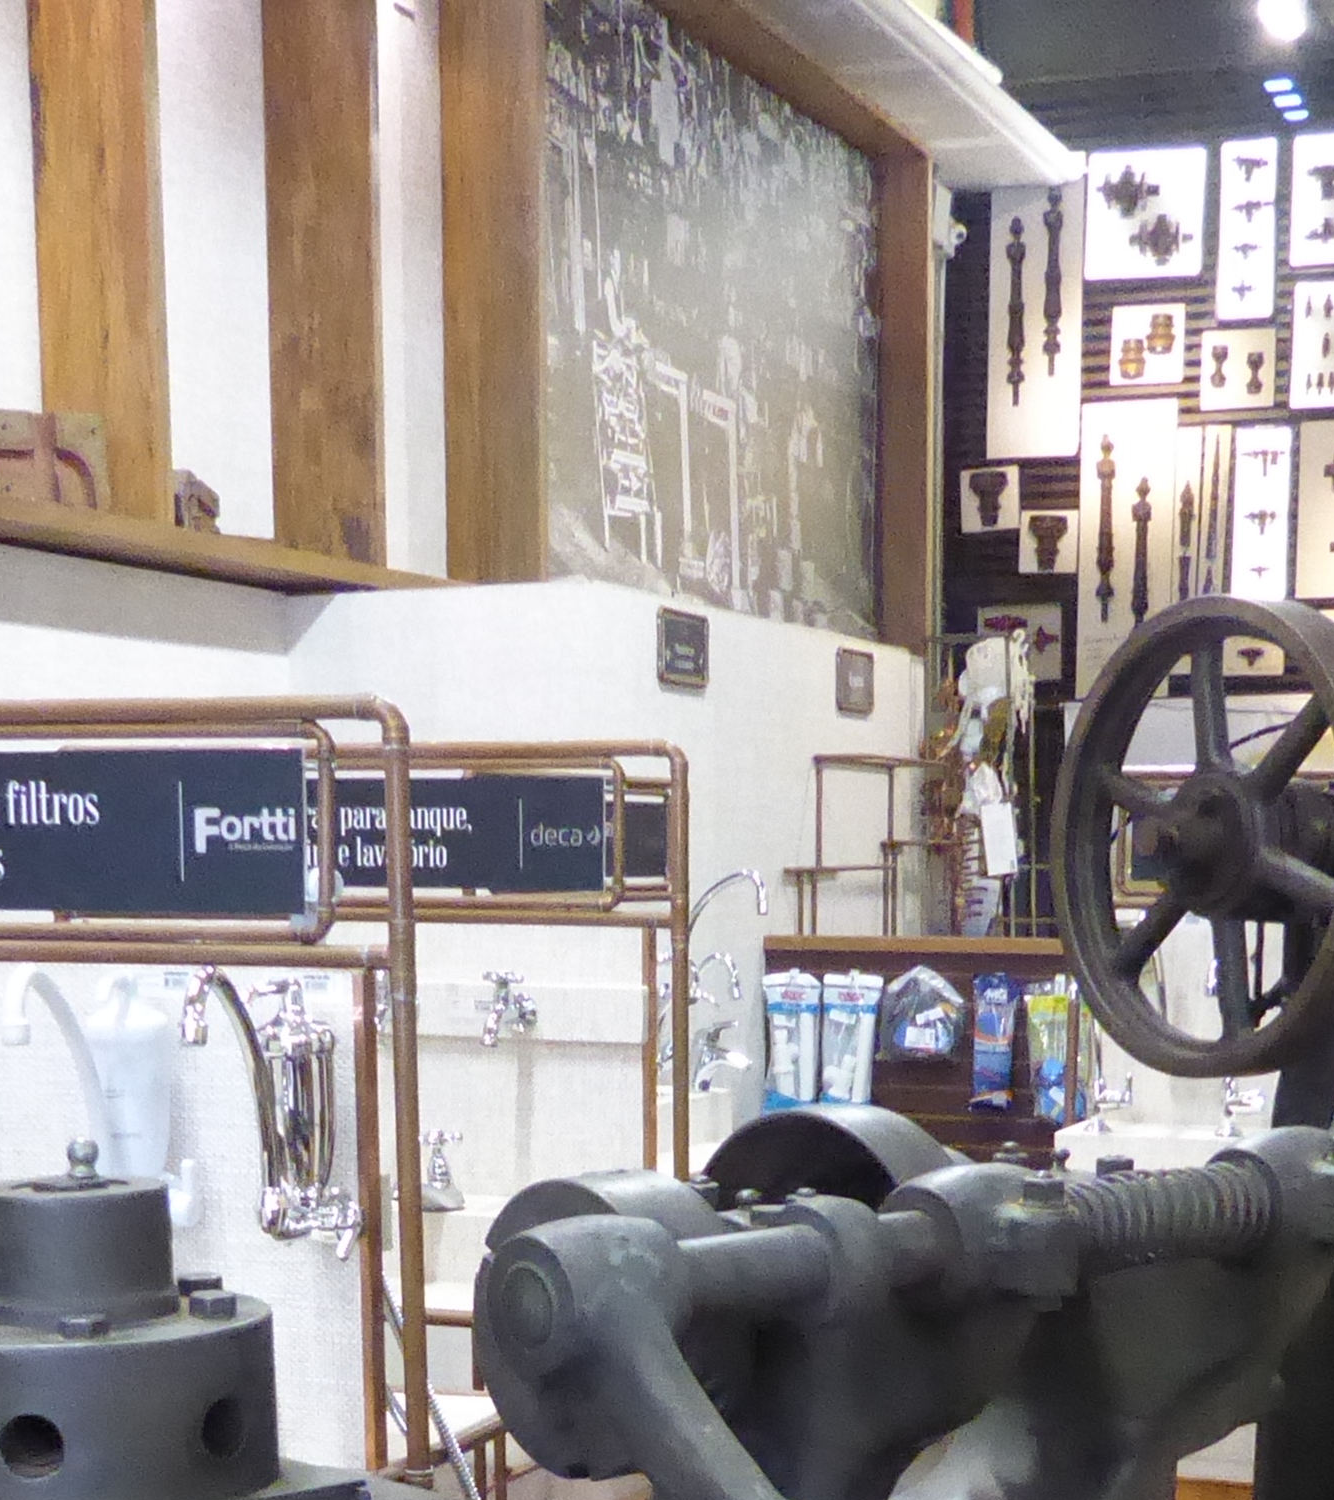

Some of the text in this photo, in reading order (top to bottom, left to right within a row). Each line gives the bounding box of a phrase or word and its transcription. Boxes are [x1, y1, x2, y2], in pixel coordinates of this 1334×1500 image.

[5, 779, 100, 826] filtros
[193, 806, 296, 854] Fortti
[340, 807, 386, 836] para
[410, 807, 473, 838] anque,
[530, 822, 584, 848] deca
[338, 845, 350, 867] e
[356, 836, 448, 868] lavório
